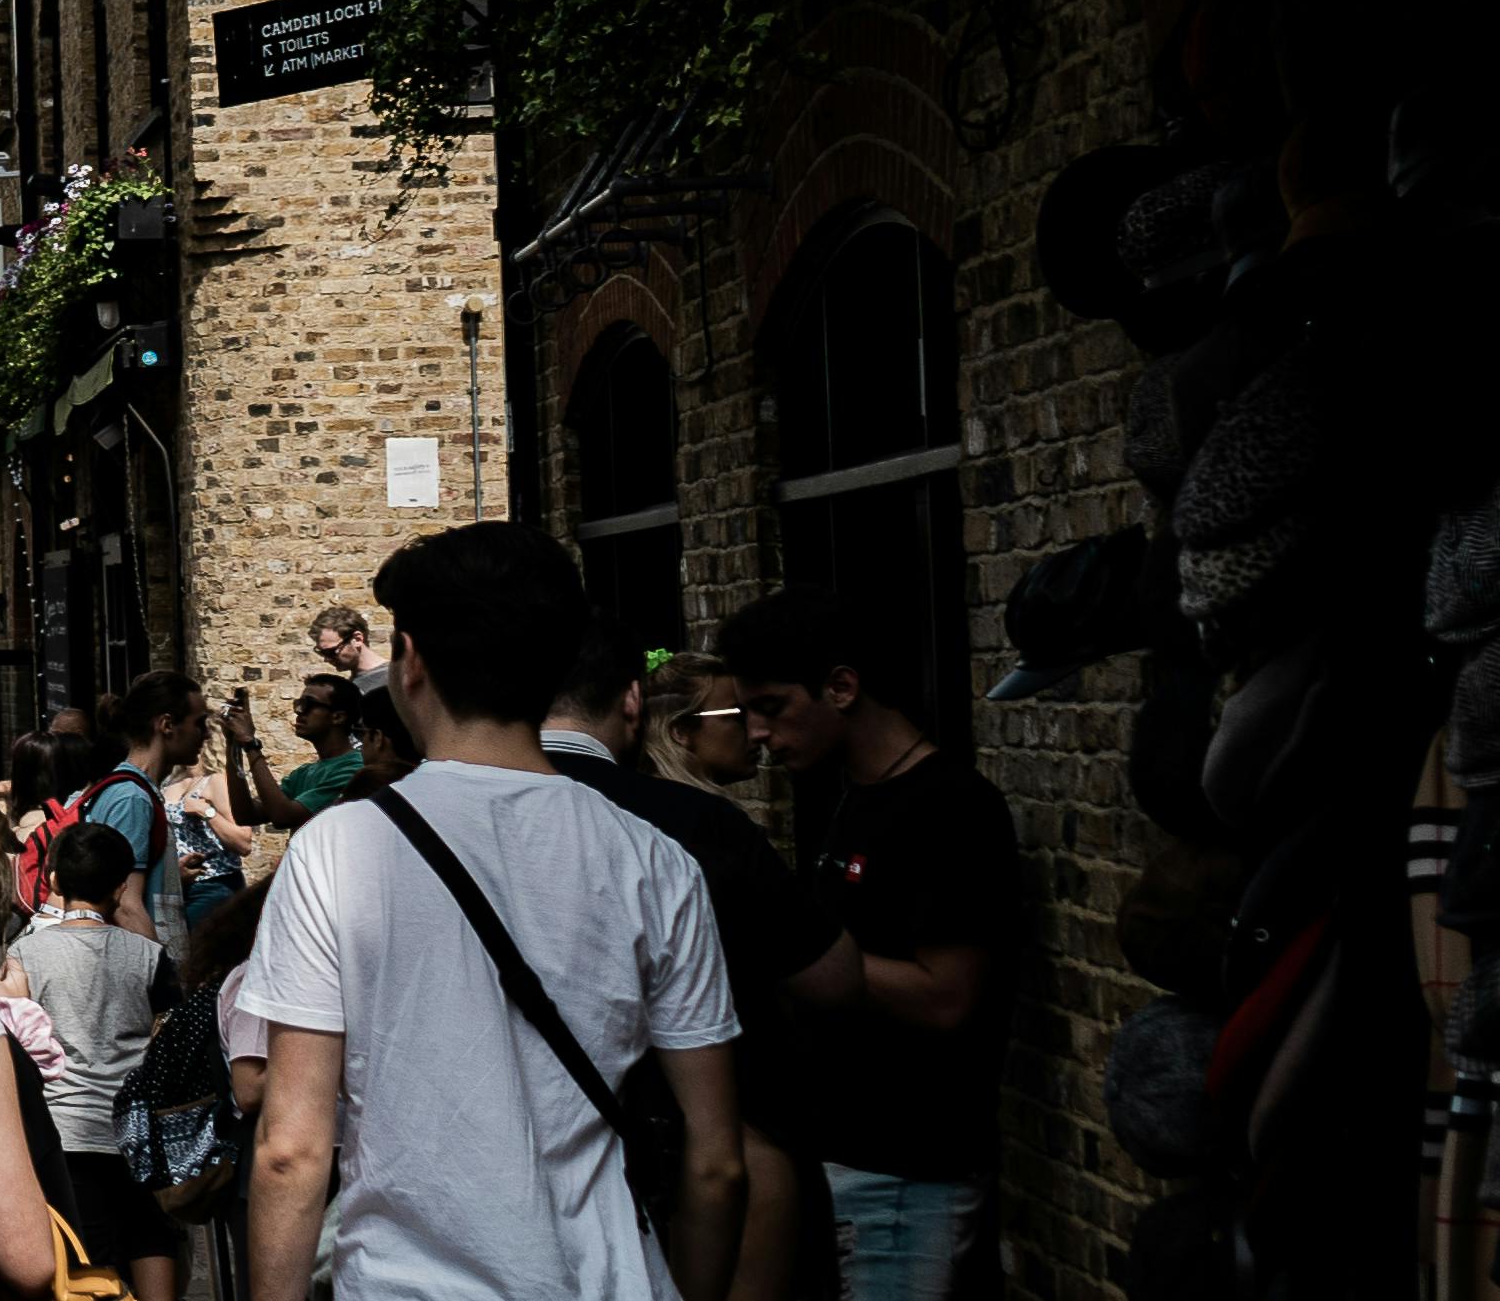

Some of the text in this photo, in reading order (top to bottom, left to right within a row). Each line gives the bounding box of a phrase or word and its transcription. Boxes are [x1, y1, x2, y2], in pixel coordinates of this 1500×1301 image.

[261, 13, 321, 38] CAMDEN
[325, 3, 365, 24] LOCK
[279, 31, 330, 54] TOILETS
[281, 55, 308, 74] ATM
